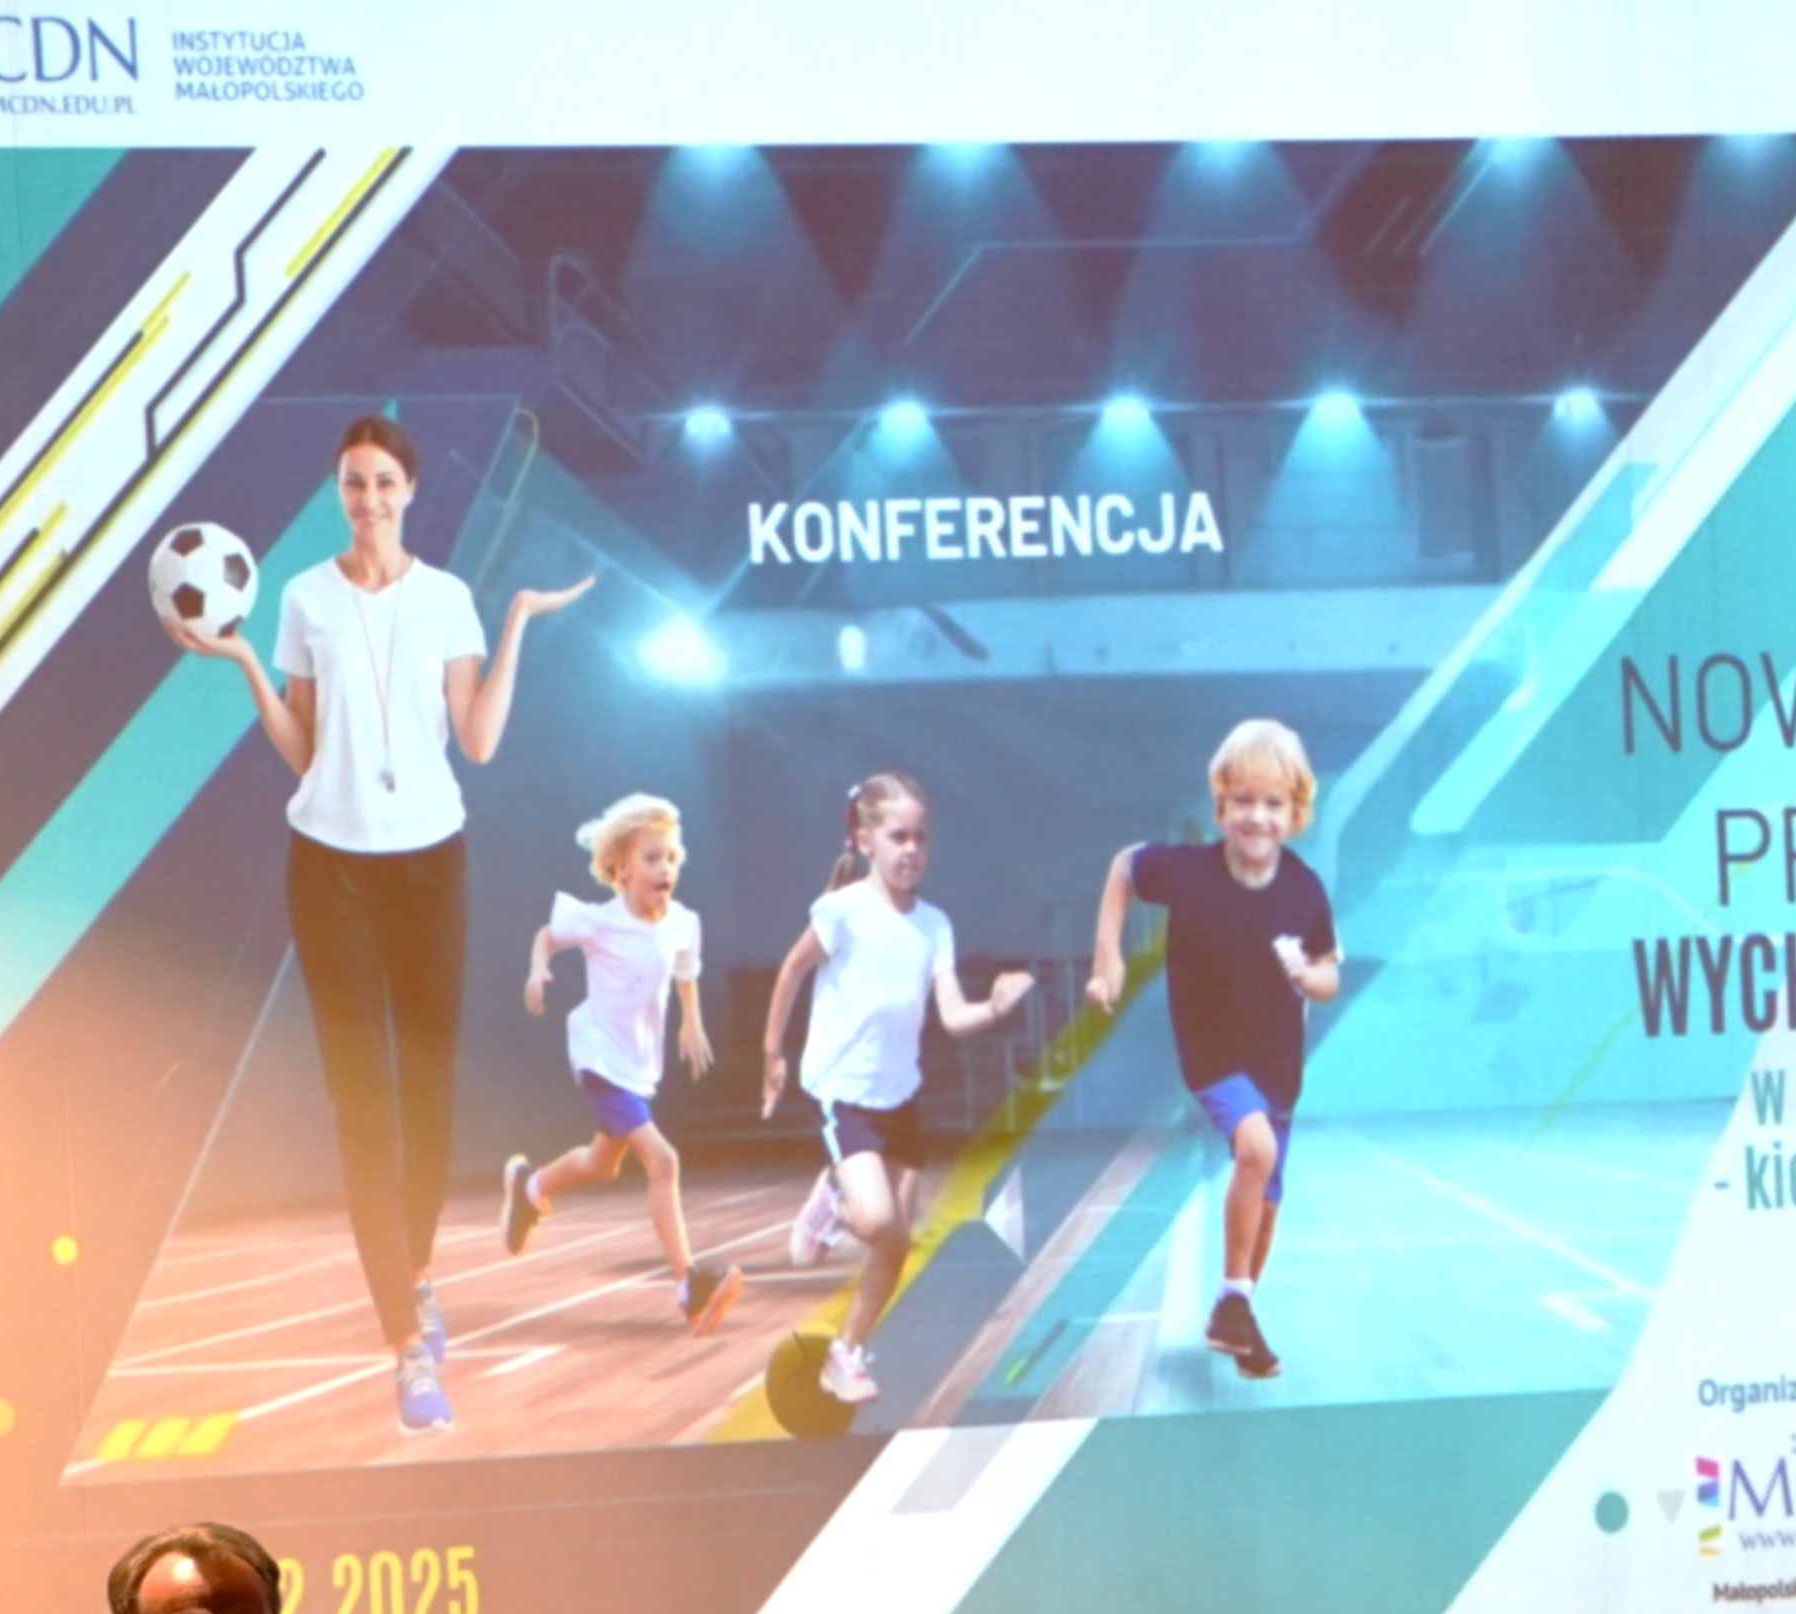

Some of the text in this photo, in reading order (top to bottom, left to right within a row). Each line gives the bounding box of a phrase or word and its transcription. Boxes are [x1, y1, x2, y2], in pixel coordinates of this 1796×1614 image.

[171, 31, 306, 53] INSTYTUCJA
[173, 54, 357, 77] WOJEWÓDZTWA
[174, 80, 365, 101] MAŁOPOLSKIEGO
[748, 491, 1225, 564] KONFERENCJA
[1751, 1067, 1787, 1126] w
